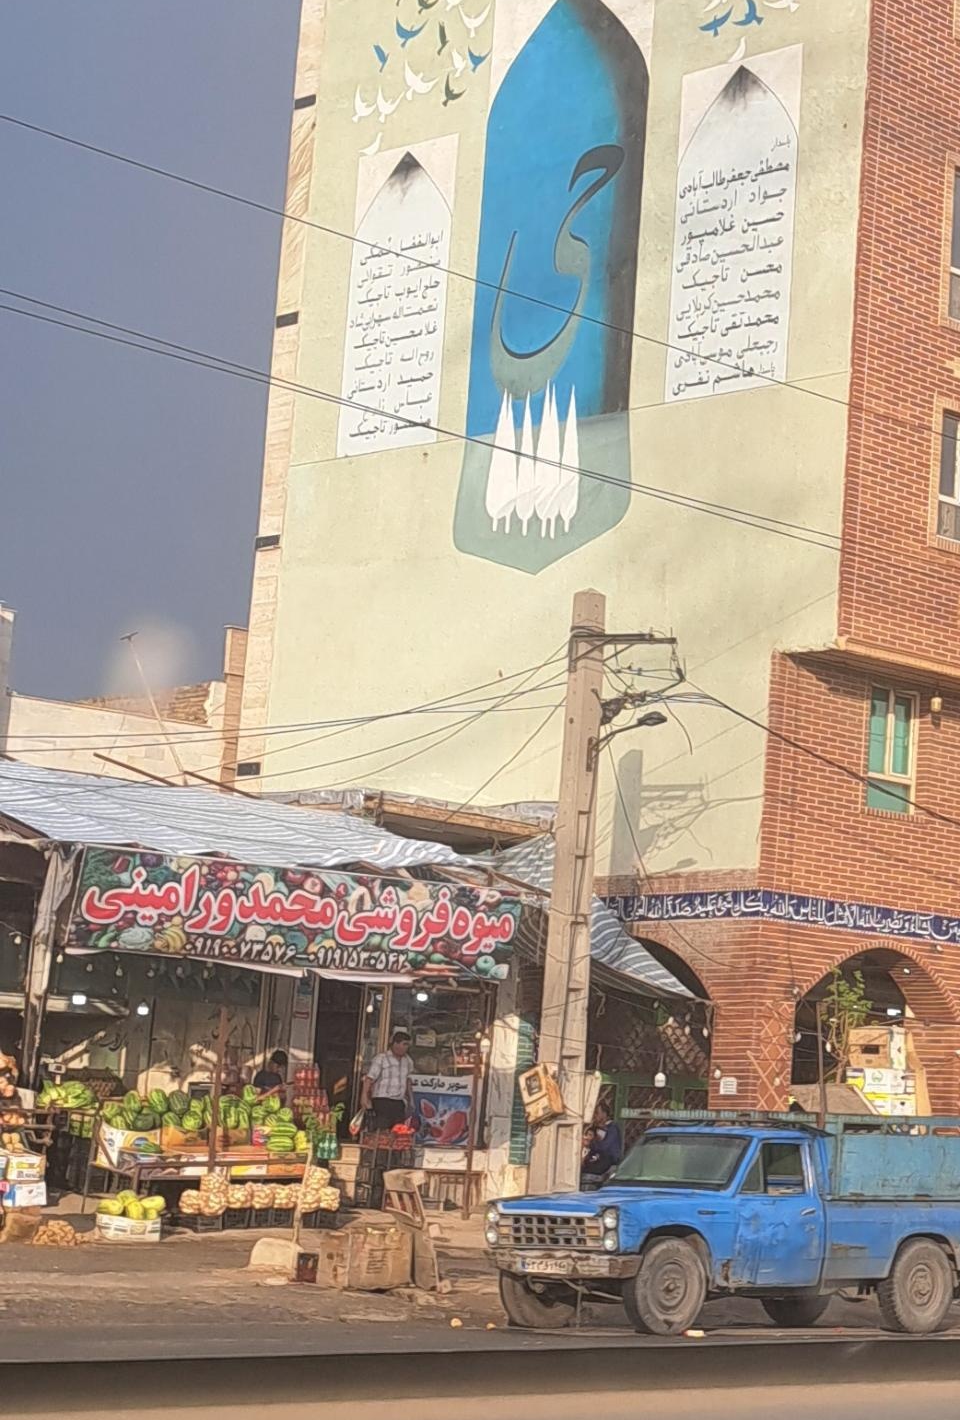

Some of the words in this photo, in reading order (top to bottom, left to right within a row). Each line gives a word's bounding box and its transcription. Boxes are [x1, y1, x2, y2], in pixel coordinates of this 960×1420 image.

[723, 168, 752, 189] جعفر
[751, 157, 790, 182] مصطفی
[680, 188, 737, 224] اردستانی
[748, 185, 787, 205] جواد
[741, 211, 784, 233] حسین
[676, 239, 712, 273] صادقی
[711, 234, 784, 266] عبدالحسین
[681, 264, 730, 291] تاجیک
[740, 263, 782, 283] محسن
[357, 284, 392, 308] تاجیک
[394, 277, 422, 301] ایوب
[422, 275, 441, 300] حاج
[677, 315, 720, 341] تاجیک
[353, 331, 385, 352] تاجیک
[354, 352, 394, 374] تاجیک
[347, 372, 391, 400] اردستانی
[397, 372, 433, 388] حمید
[348, 418, 386, 441] تاجیک
[82, 863, 236, 935] ورامینی
[236, 880, 338, 929] محمد
[334, 884, 452, 952] فروشی
[451, 905, 515, 954] میوه
[420, 1078, 445, 1090] مارکت
